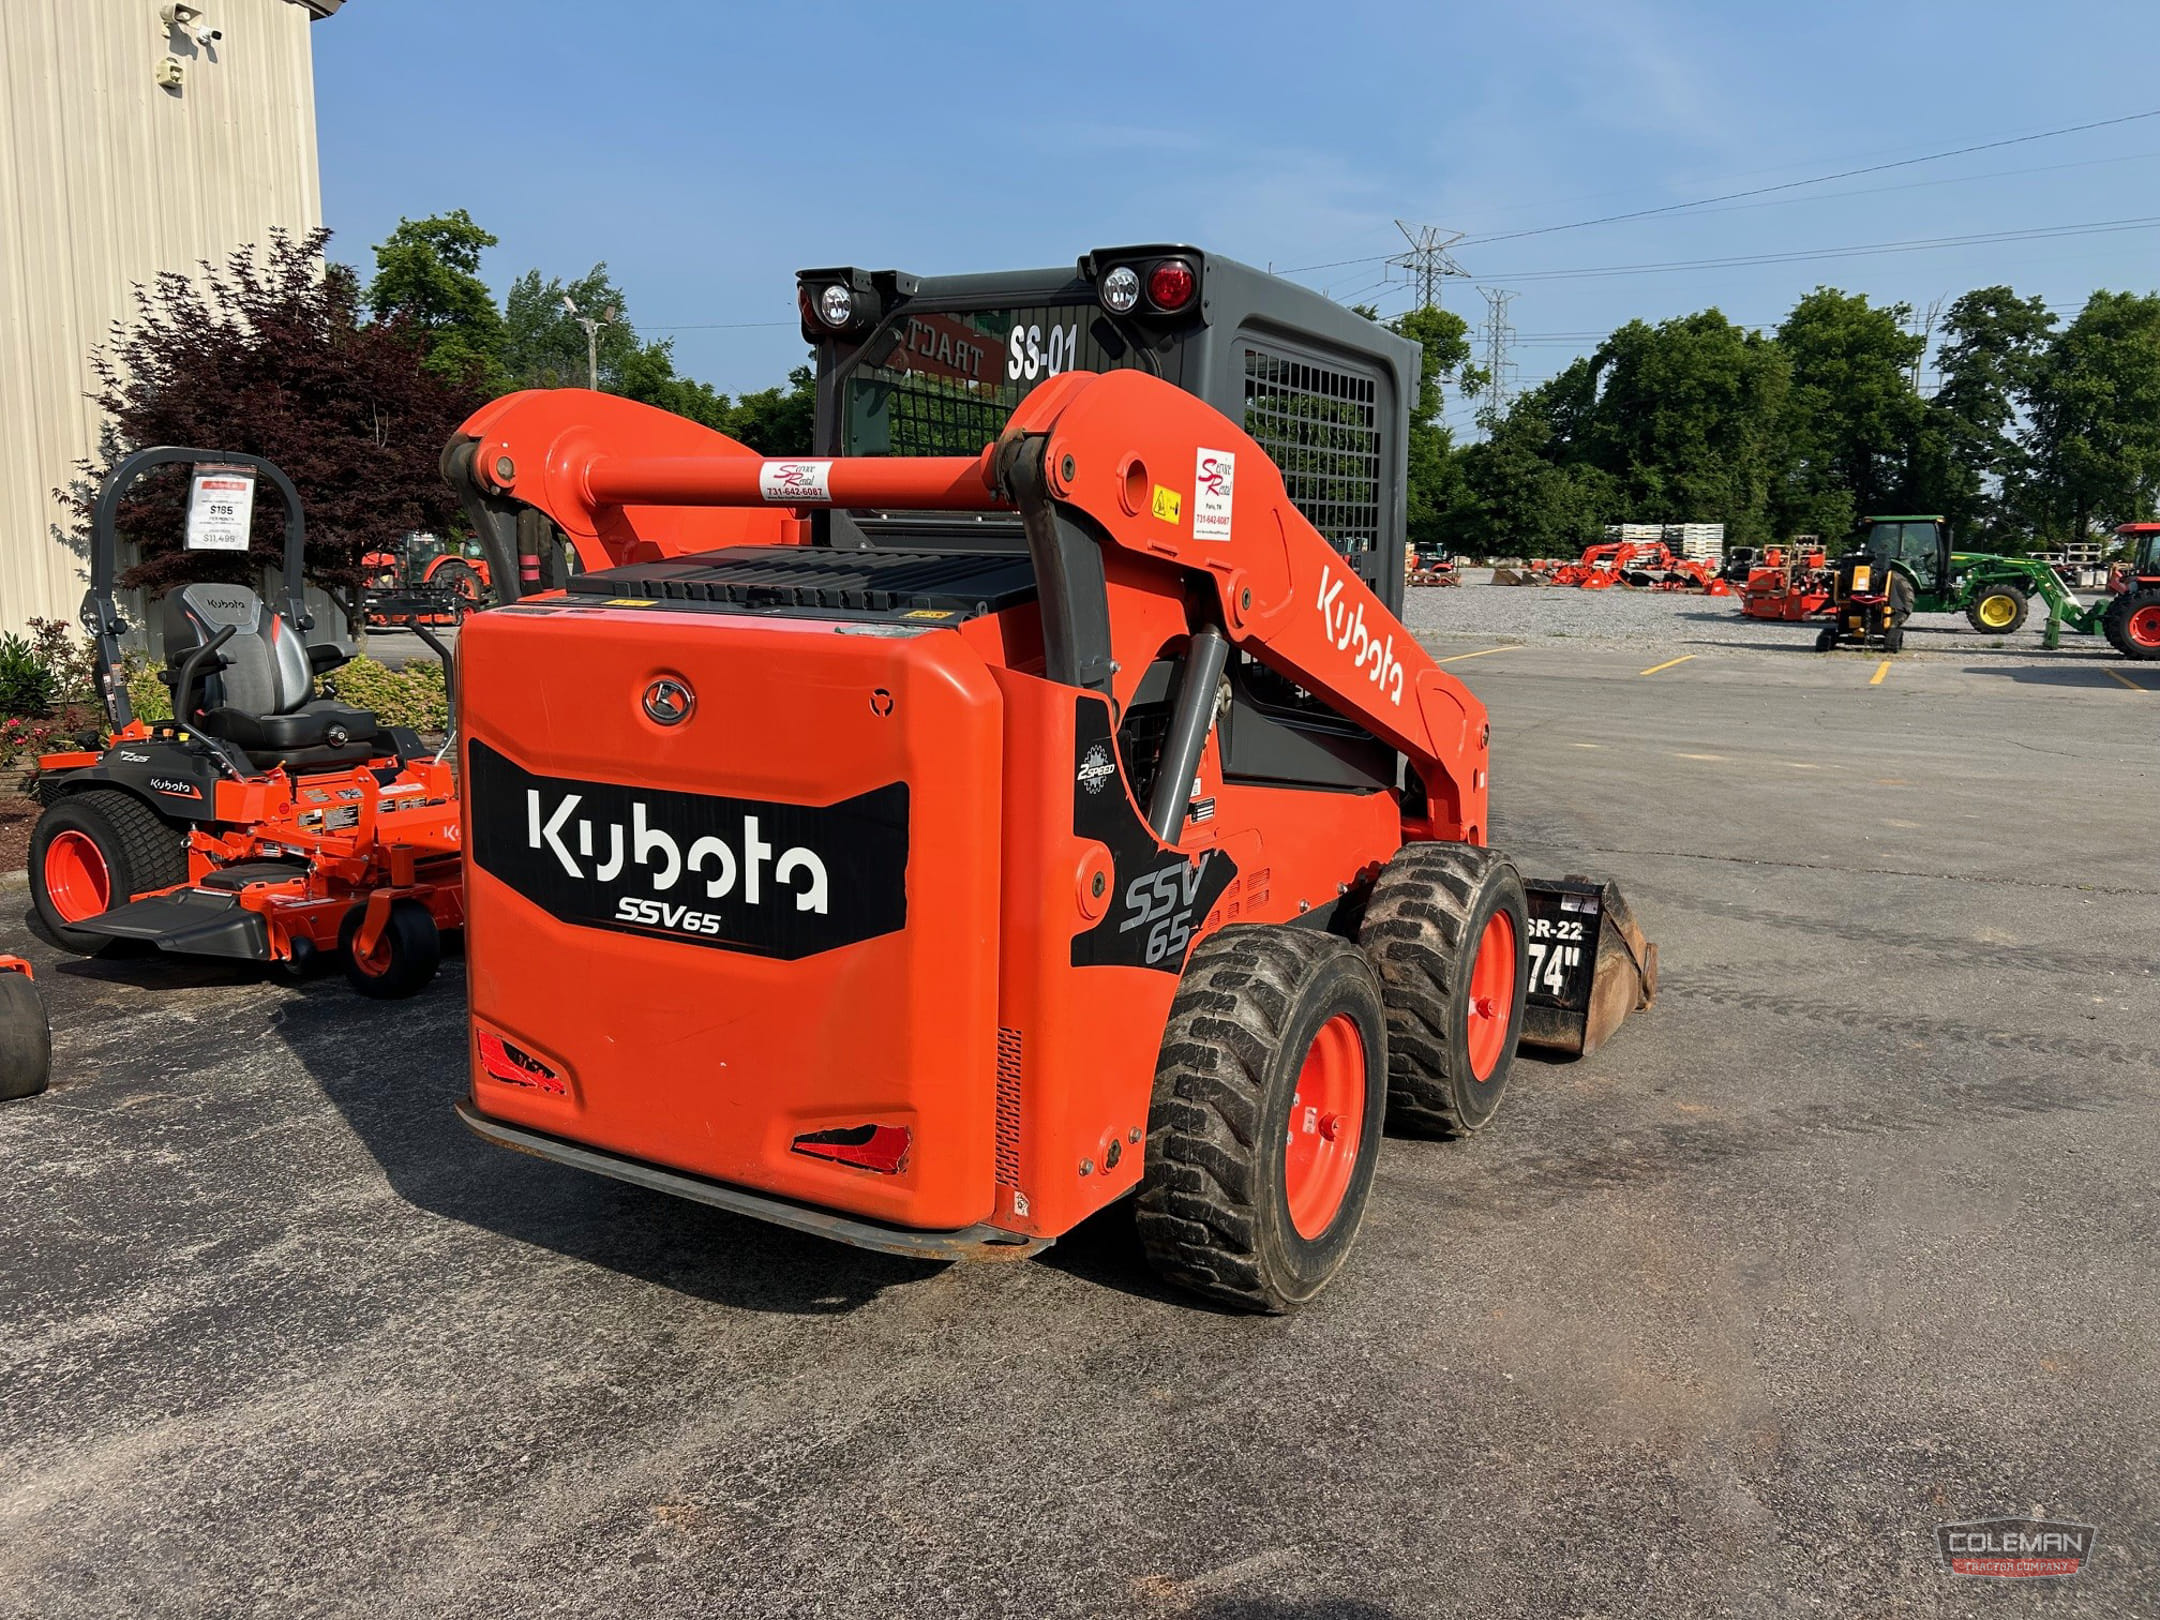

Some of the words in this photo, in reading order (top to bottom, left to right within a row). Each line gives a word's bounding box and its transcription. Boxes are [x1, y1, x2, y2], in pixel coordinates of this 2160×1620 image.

[1008, 324, 1078, 381] SS-01
[767, 487, 823, 496] 731-642-6087
[1196, 513, 1230, 526] 731-642-6087
[207, 599, 246, 609] Kubota
[1316, 565, 1404, 706] Kubota
[150, 778, 191, 793] Kubota
[527, 789, 829, 915] Kubota
[615, 896, 722, 935] SSV65
[1120, 852, 1211, 934] SSV
[1146, 908, 1193, 965] 65
